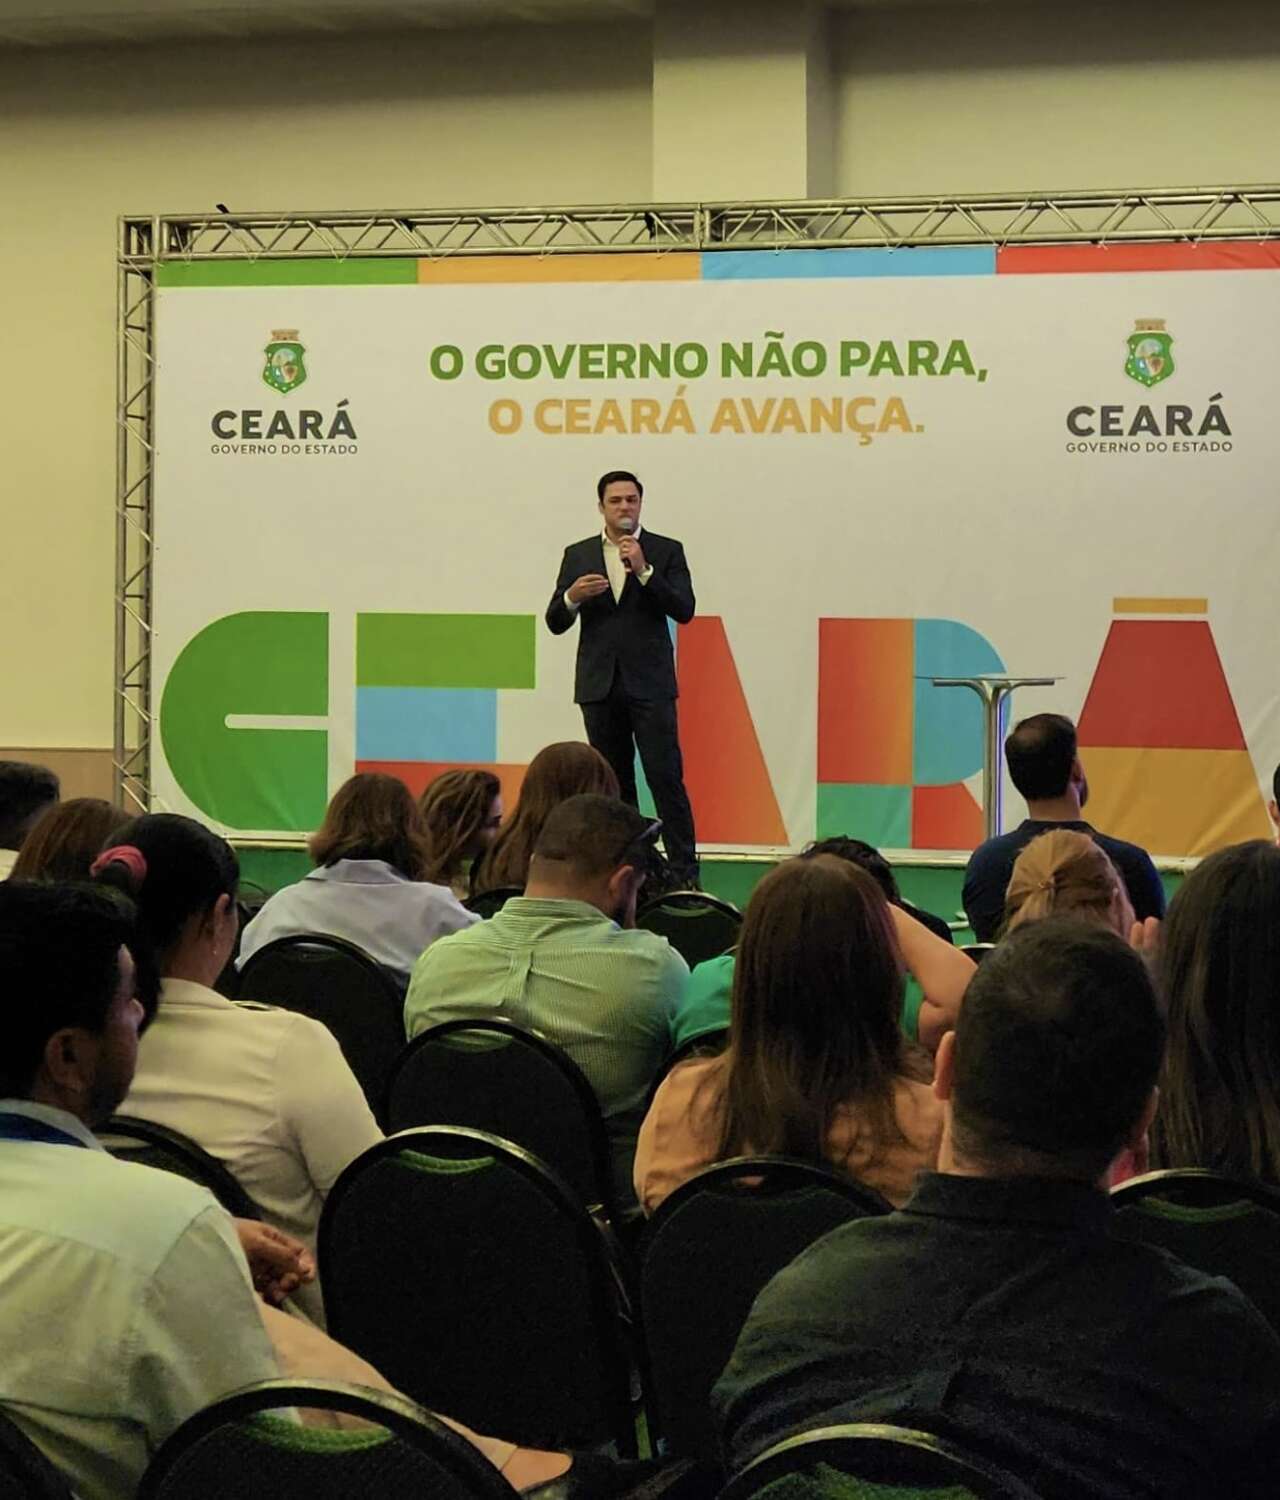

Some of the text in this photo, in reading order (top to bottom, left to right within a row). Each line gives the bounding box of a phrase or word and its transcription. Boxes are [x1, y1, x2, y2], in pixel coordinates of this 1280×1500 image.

[430, 331, 988, 382] O GOVERNO NÃO PARA,
[211, 399, 357, 439] CEARÁ
[488, 384, 925, 446] O CEARÁ AVANÇA.
[1066, 392, 1232, 437] CEARÁ
[211, 444, 358, 454] GOVERNO DO ESTADO
[1066, 441, 1232, 453] GOVERNO DO ESTADO
